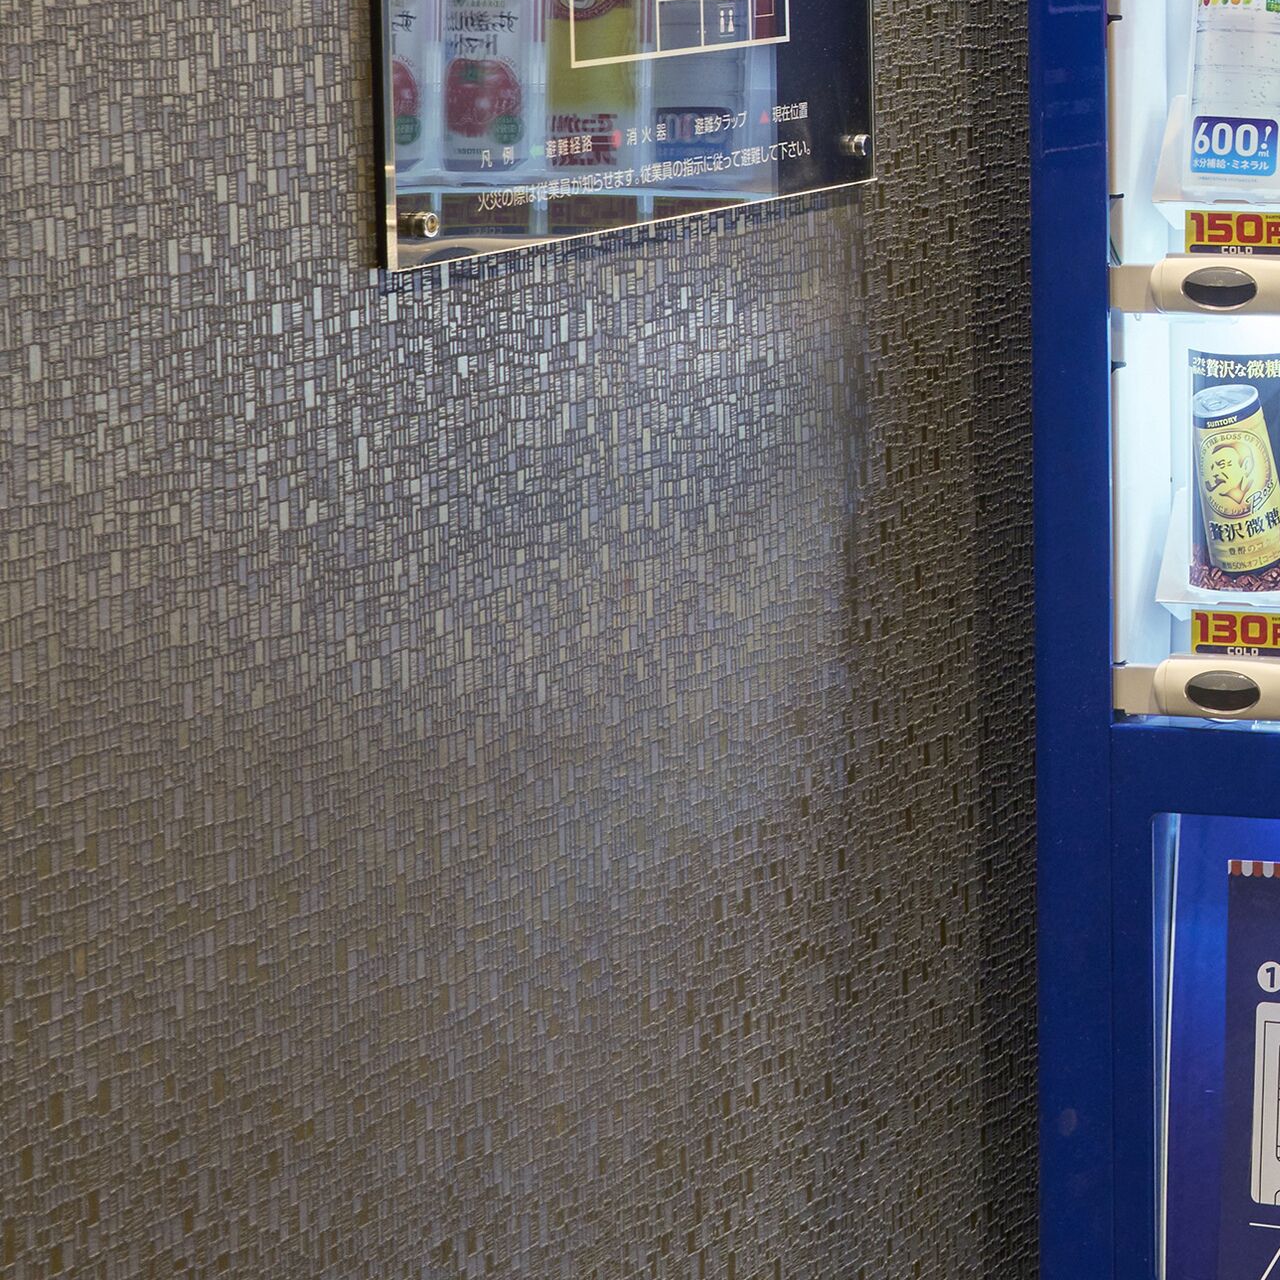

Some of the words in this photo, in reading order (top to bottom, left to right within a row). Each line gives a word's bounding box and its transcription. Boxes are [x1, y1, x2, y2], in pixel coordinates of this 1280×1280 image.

[772, 102, 808, 122] 現在位置
[694, 112, 747, 136] 避難タラップ
[545, 139, 593, 159] 避難経路
